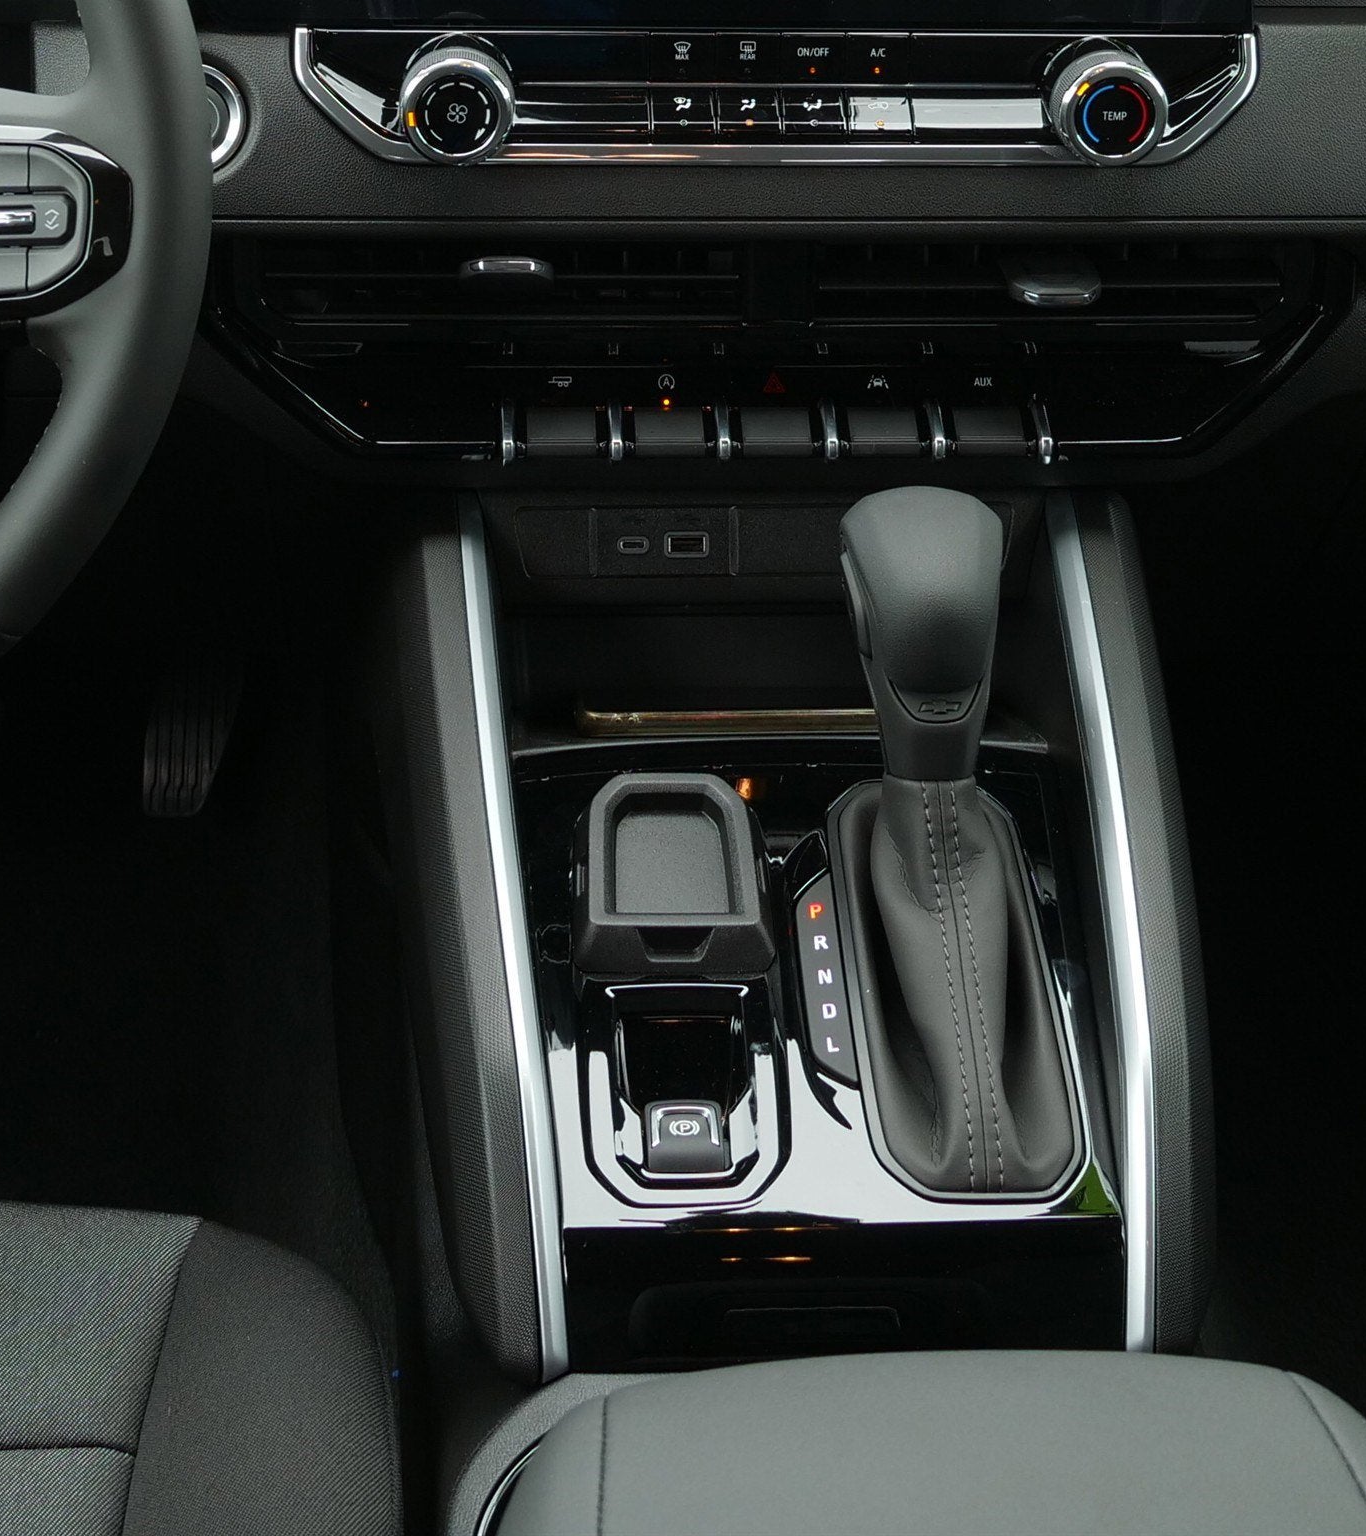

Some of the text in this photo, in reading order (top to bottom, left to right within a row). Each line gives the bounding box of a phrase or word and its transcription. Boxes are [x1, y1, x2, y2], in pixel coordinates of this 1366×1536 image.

[675, 52, 689, 60] MAX
[740, 52, 756, 60] REAR
[797, 48, 829, 57] ON/OFF
[870, 48, 886, 57] A/C
[1103, 111, 1127, 120] TEMP
[974, 377, 992, 387] AUX
[809, 904, 839, 1052] P R N D L
